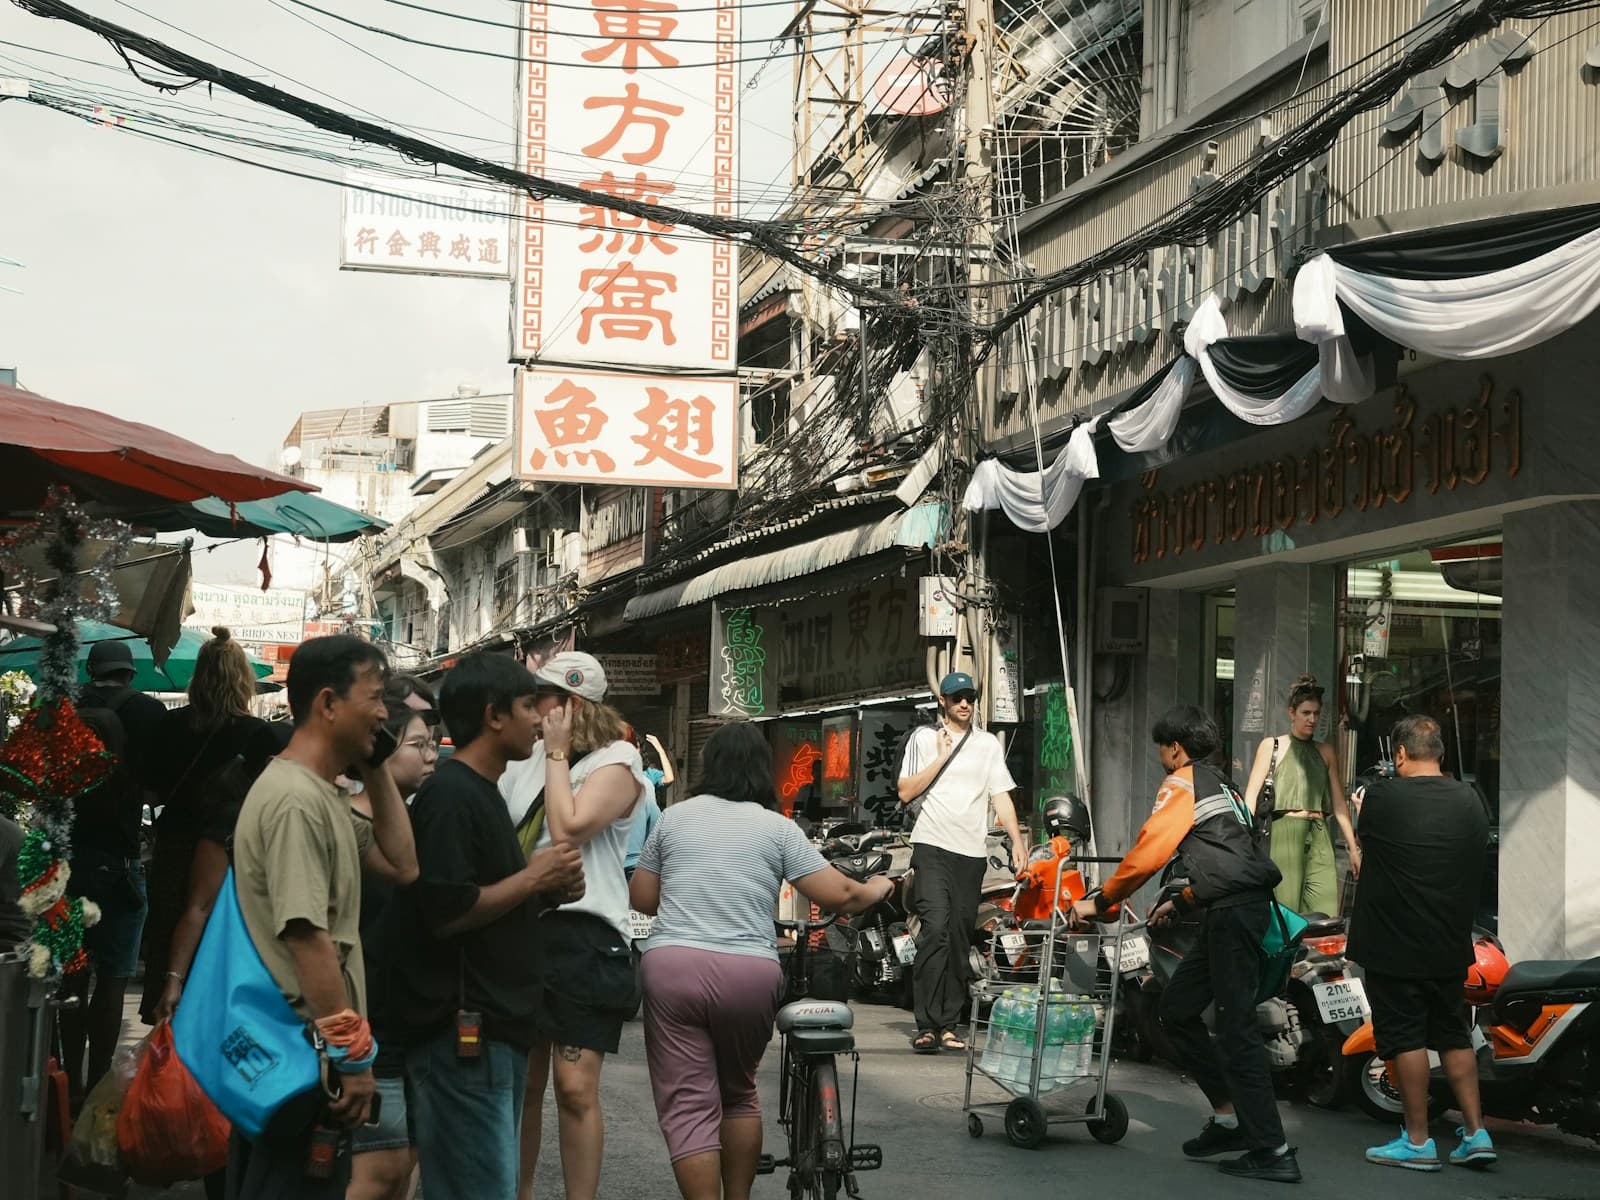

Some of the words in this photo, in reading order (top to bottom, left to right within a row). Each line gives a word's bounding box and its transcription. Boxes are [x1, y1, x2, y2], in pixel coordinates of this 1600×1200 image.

[529, 377, 724, 479] 魚翅
[277, 629, 301, 641] NEST
[847, 577, 920, 664] 東方
[1329, 1005, 1363, 1020] 5544
